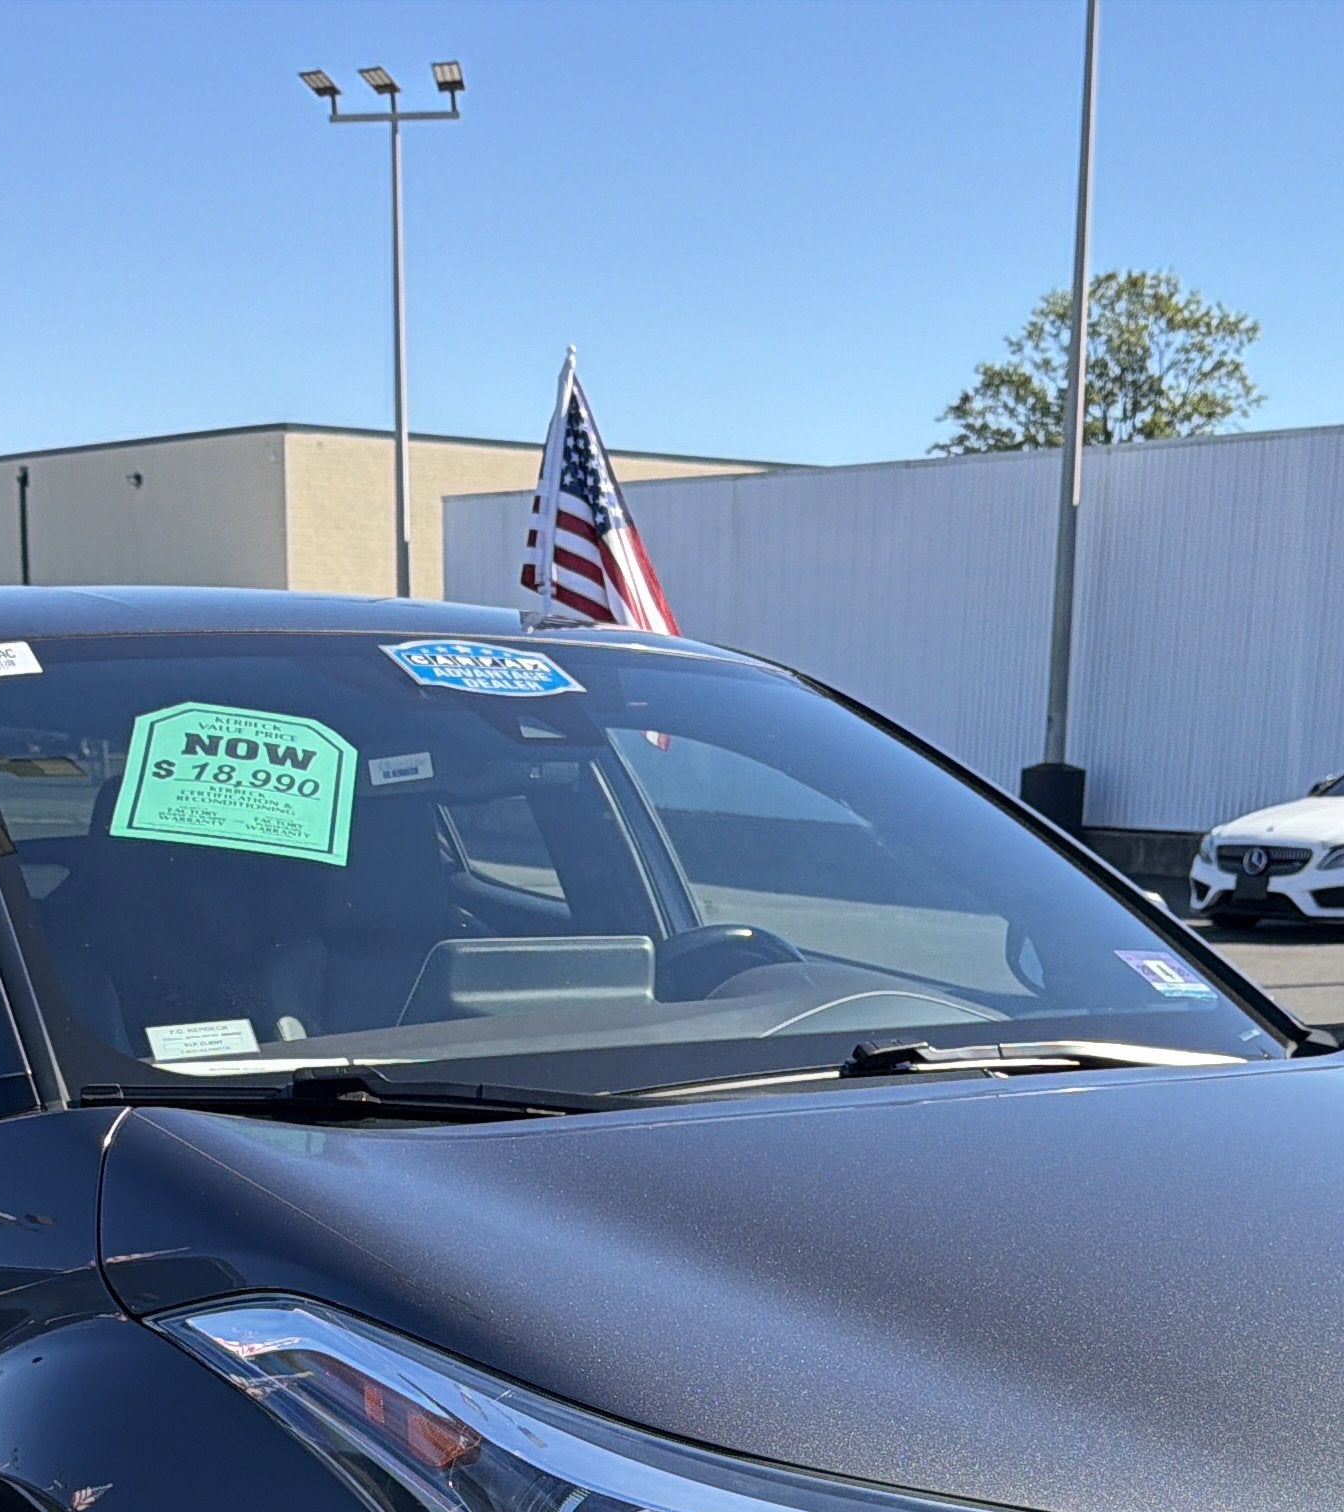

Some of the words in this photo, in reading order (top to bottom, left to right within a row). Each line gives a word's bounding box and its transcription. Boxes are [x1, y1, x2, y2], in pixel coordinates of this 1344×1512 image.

[433, 667, 553, 683] ADVANTAGE
[463, 678, 545, 691] DEALER
[198, 722, 243, 735] VALUE
[255, 729, 298, 742] PRICE
[214, 716, 283, 732] KERBECK
[181, 732, 317, 771] NOW
[152, 759, 176, 780] $
[191, 761, 321, 798] 18,990
[209, 786, 266, 798] KERBECK
[176, 795, 296, 816] RECONDITIONING
